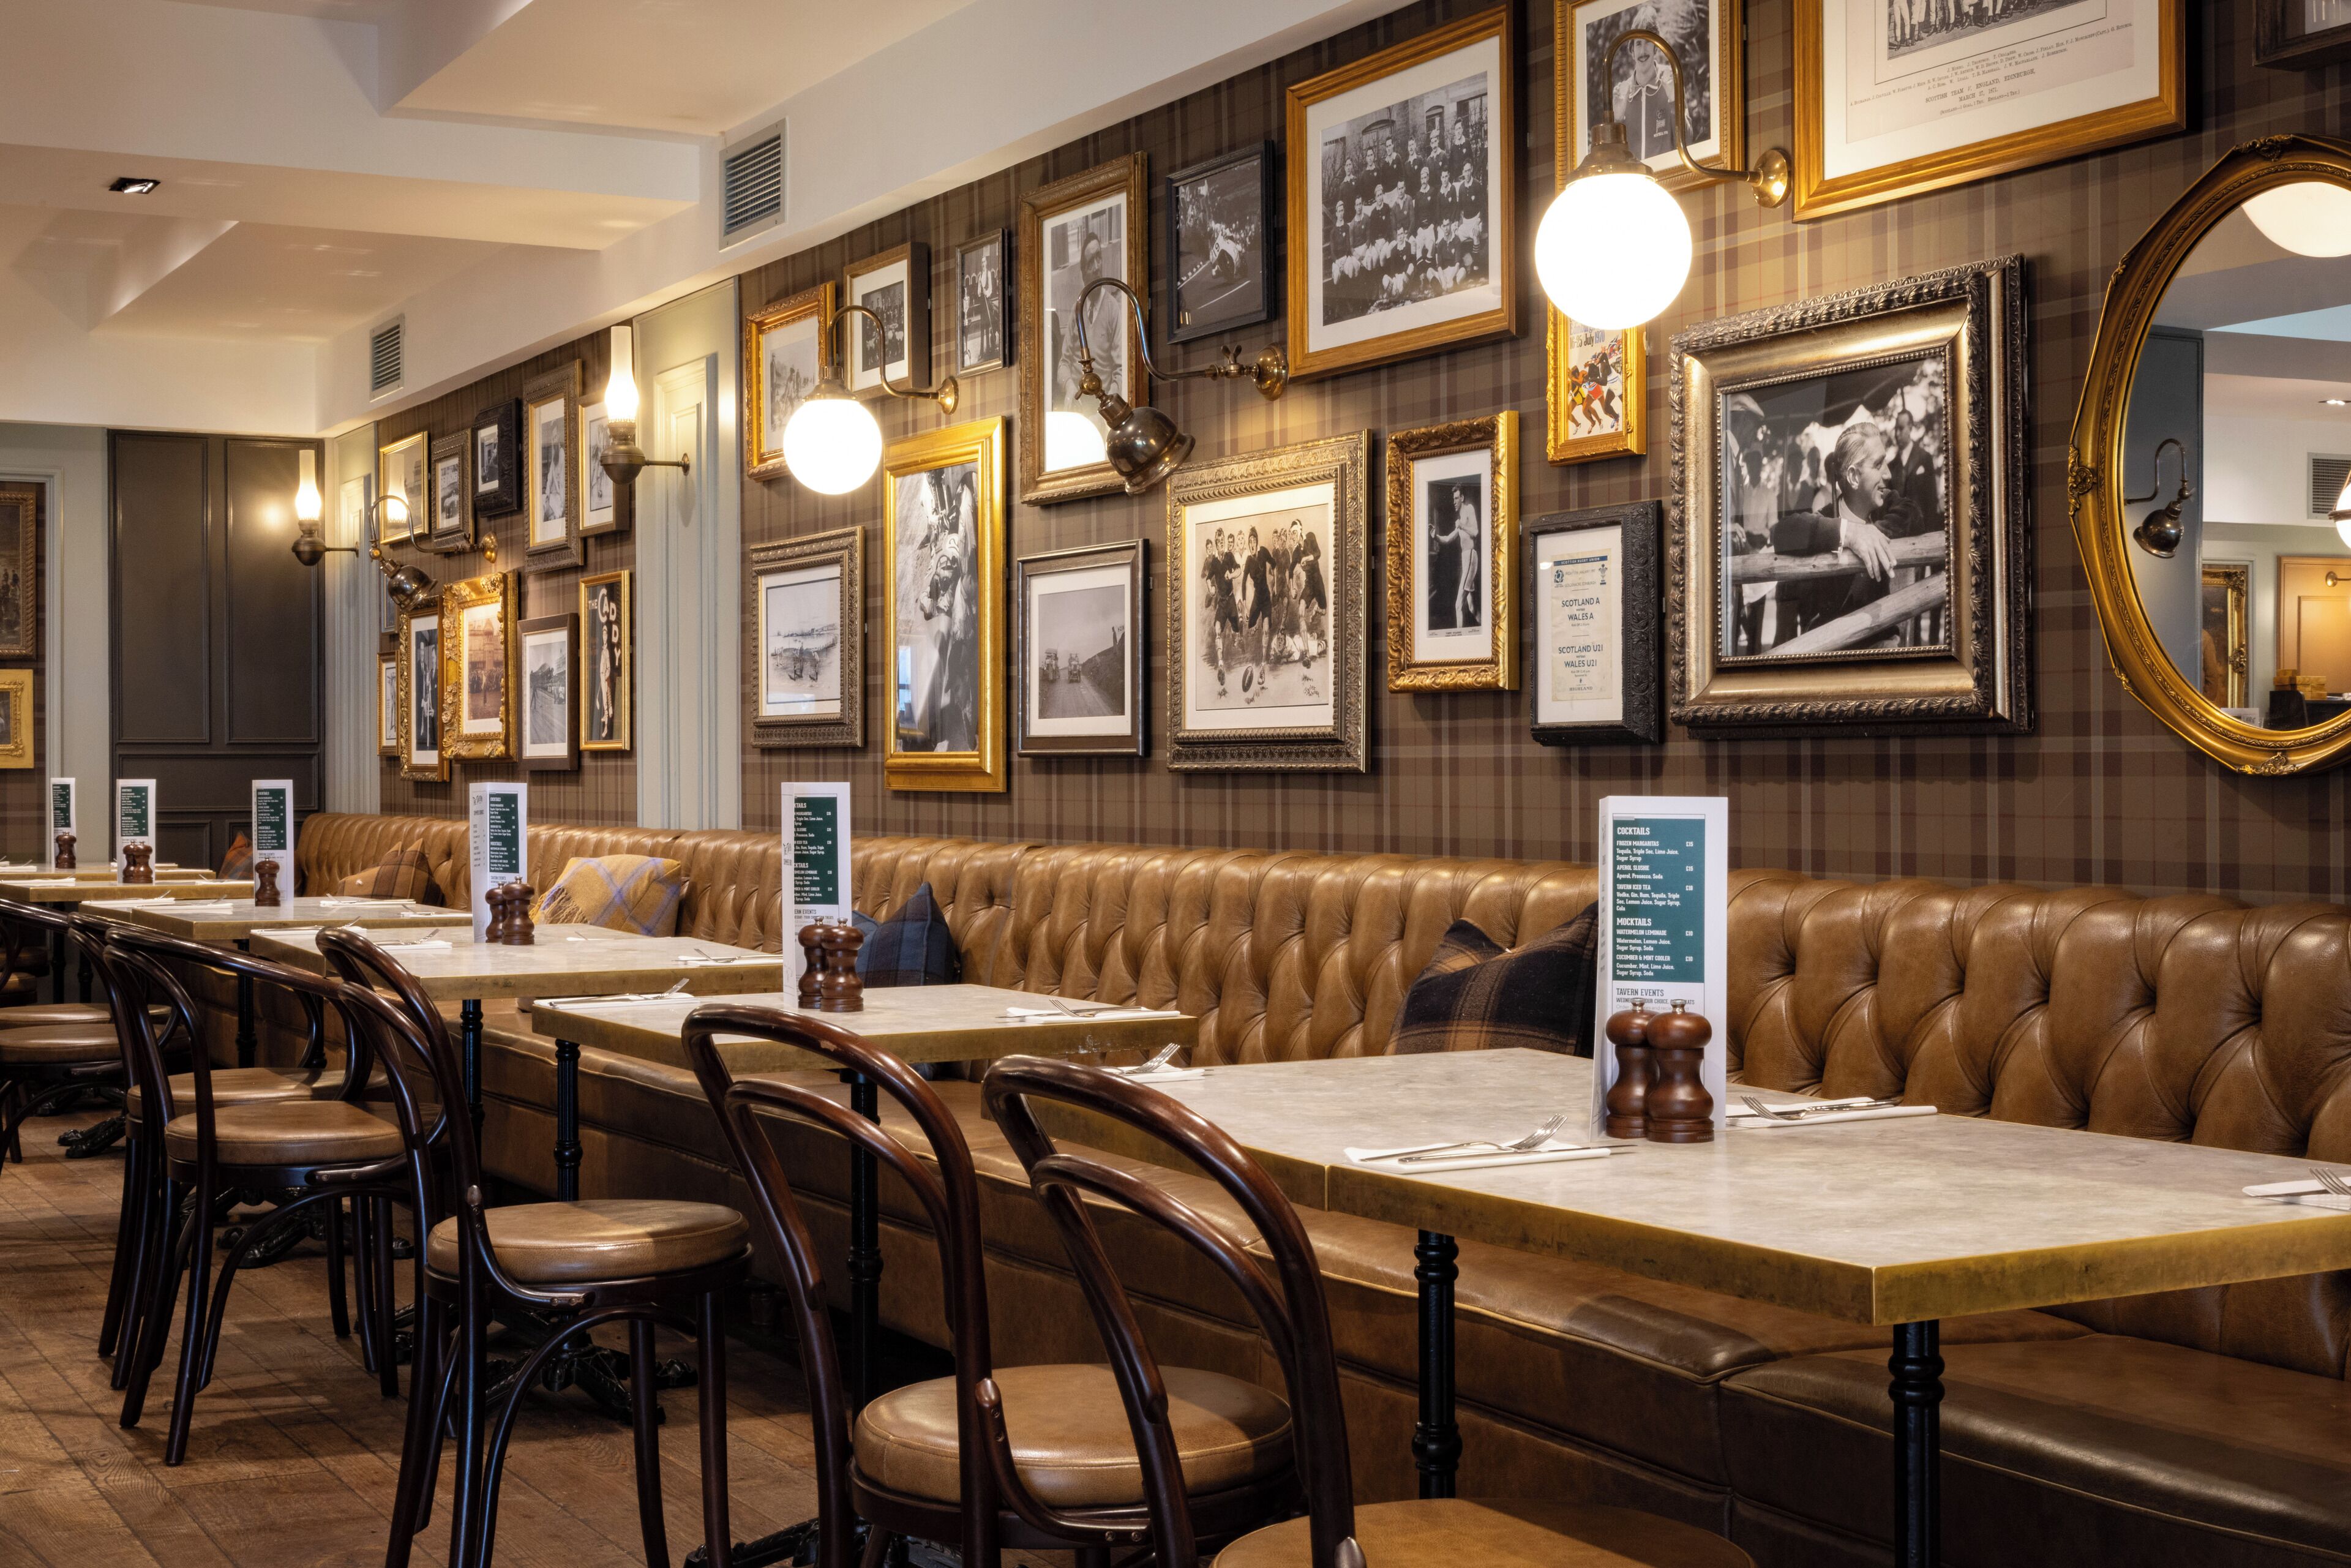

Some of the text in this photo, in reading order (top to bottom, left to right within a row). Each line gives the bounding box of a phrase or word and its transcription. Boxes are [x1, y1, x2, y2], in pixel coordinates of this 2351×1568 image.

[1925, 93, 1948, 103] SCOTTISH
[1951, 88, 1963, 97] TEAM
[1976, 78, 2000, 89] ENGLAND,
[2004, 69, 2036, 81] EDINBURGH,
[1959, 93, 1975, 102] MARCH
[1584, 333, 1594, 347] July
[1594, 330, 1605, 343] 1970
[1562, 598, 1594, 607] SCOTLAND
[588, 588, 621, 666] THE CADDY
[1558, 645, 1591, 654] SCOTLAND
[1617, 827, 1650, 836] COCKTAILS
